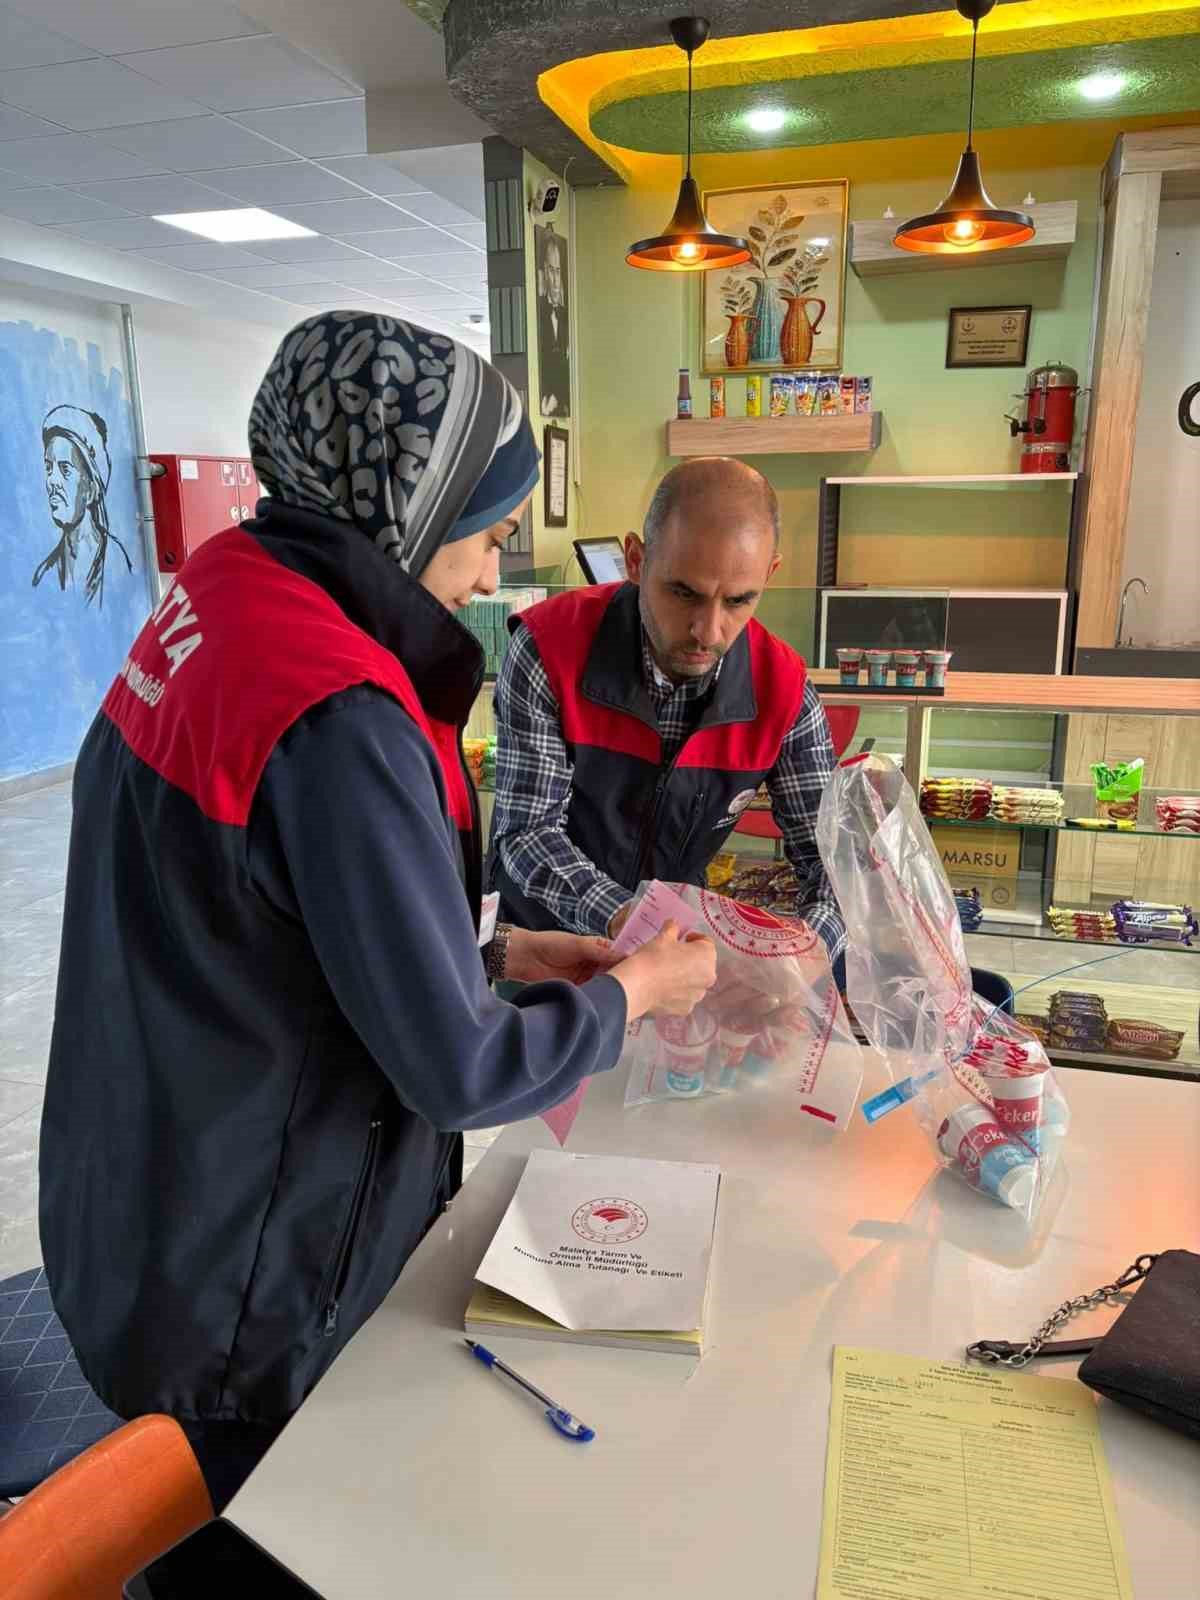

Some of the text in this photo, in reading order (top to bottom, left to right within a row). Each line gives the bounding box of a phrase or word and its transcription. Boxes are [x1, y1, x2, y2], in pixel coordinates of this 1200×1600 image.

[943, 850, 1008, 868] MARSU
[559, 1245, 598, 1256] Malatya
[549, 1251, 583, 1261] Orman
[554, 1260, 582, 1269] Alma
